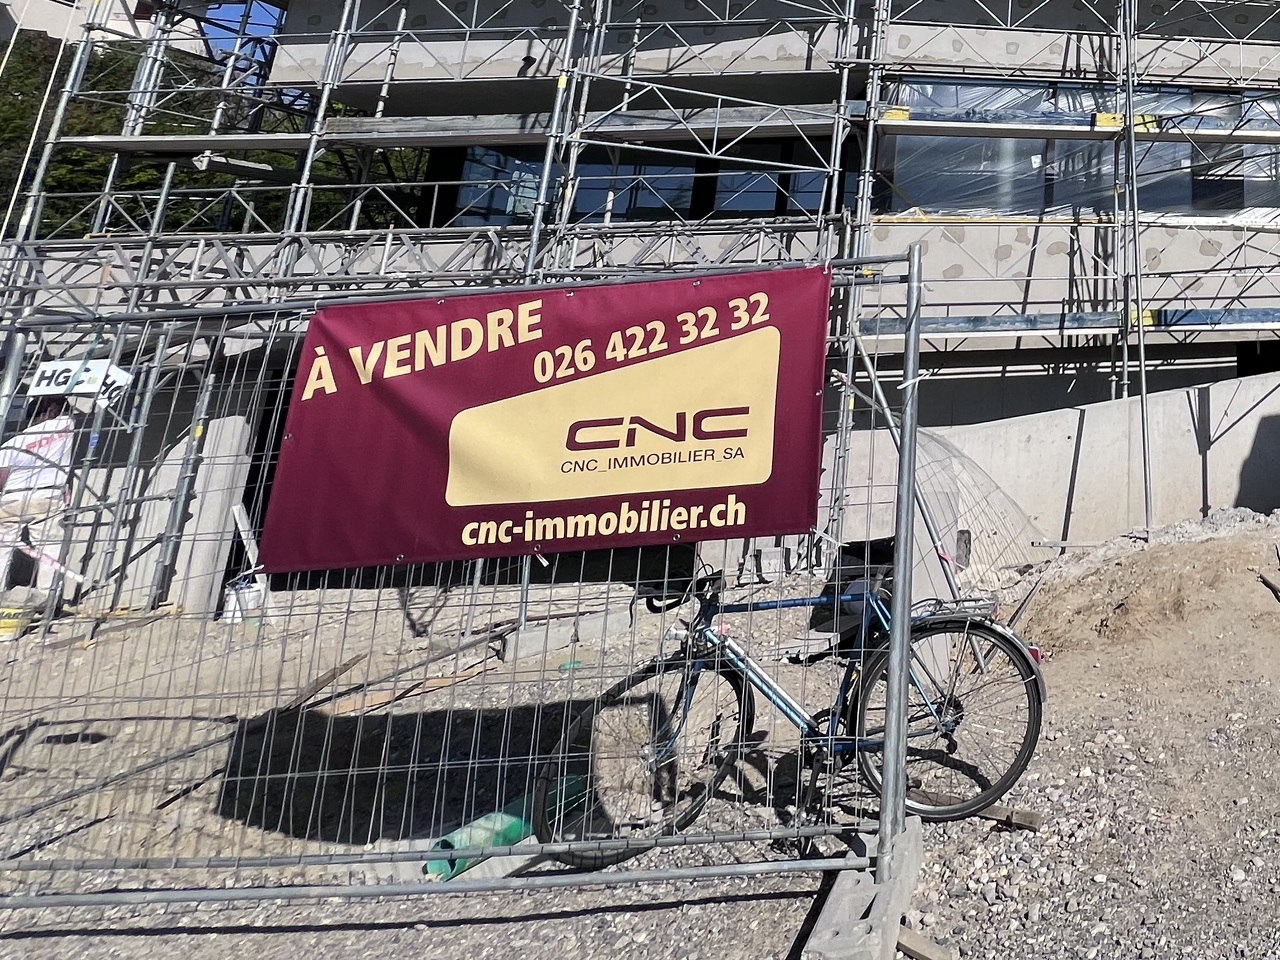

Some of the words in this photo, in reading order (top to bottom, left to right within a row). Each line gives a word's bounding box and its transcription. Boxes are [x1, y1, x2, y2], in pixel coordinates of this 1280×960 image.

[301, 345, 338, 401] À
[348, 299, 543, 385] VENDRE
[533, 339, 596, 384] 026
[605, 320, 668, 363] 422
[676, 306, 720, 345] 32
[728, 292, 770, 331] 32
[565, 406, 750, 451] CNC
[461, 494, 747, 546] cnc-immobilier.ch
